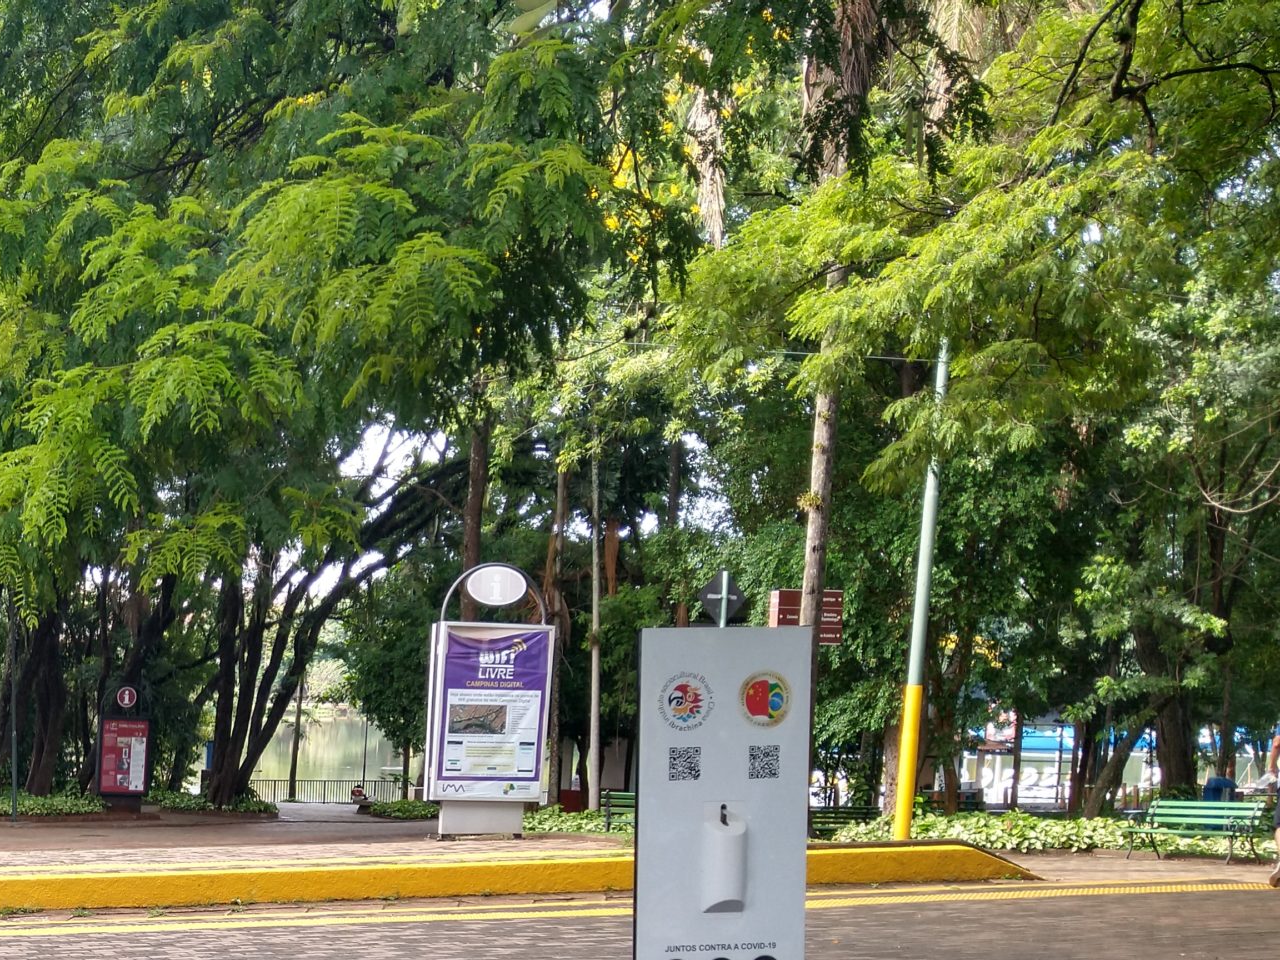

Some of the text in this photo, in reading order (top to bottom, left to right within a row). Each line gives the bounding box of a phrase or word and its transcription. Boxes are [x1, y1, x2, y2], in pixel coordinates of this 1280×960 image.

[478, 668, 514, 679] LIVRE
[699, 943, 732, 951] CONTRA
[741, 942, 776, 950] COVID-19
